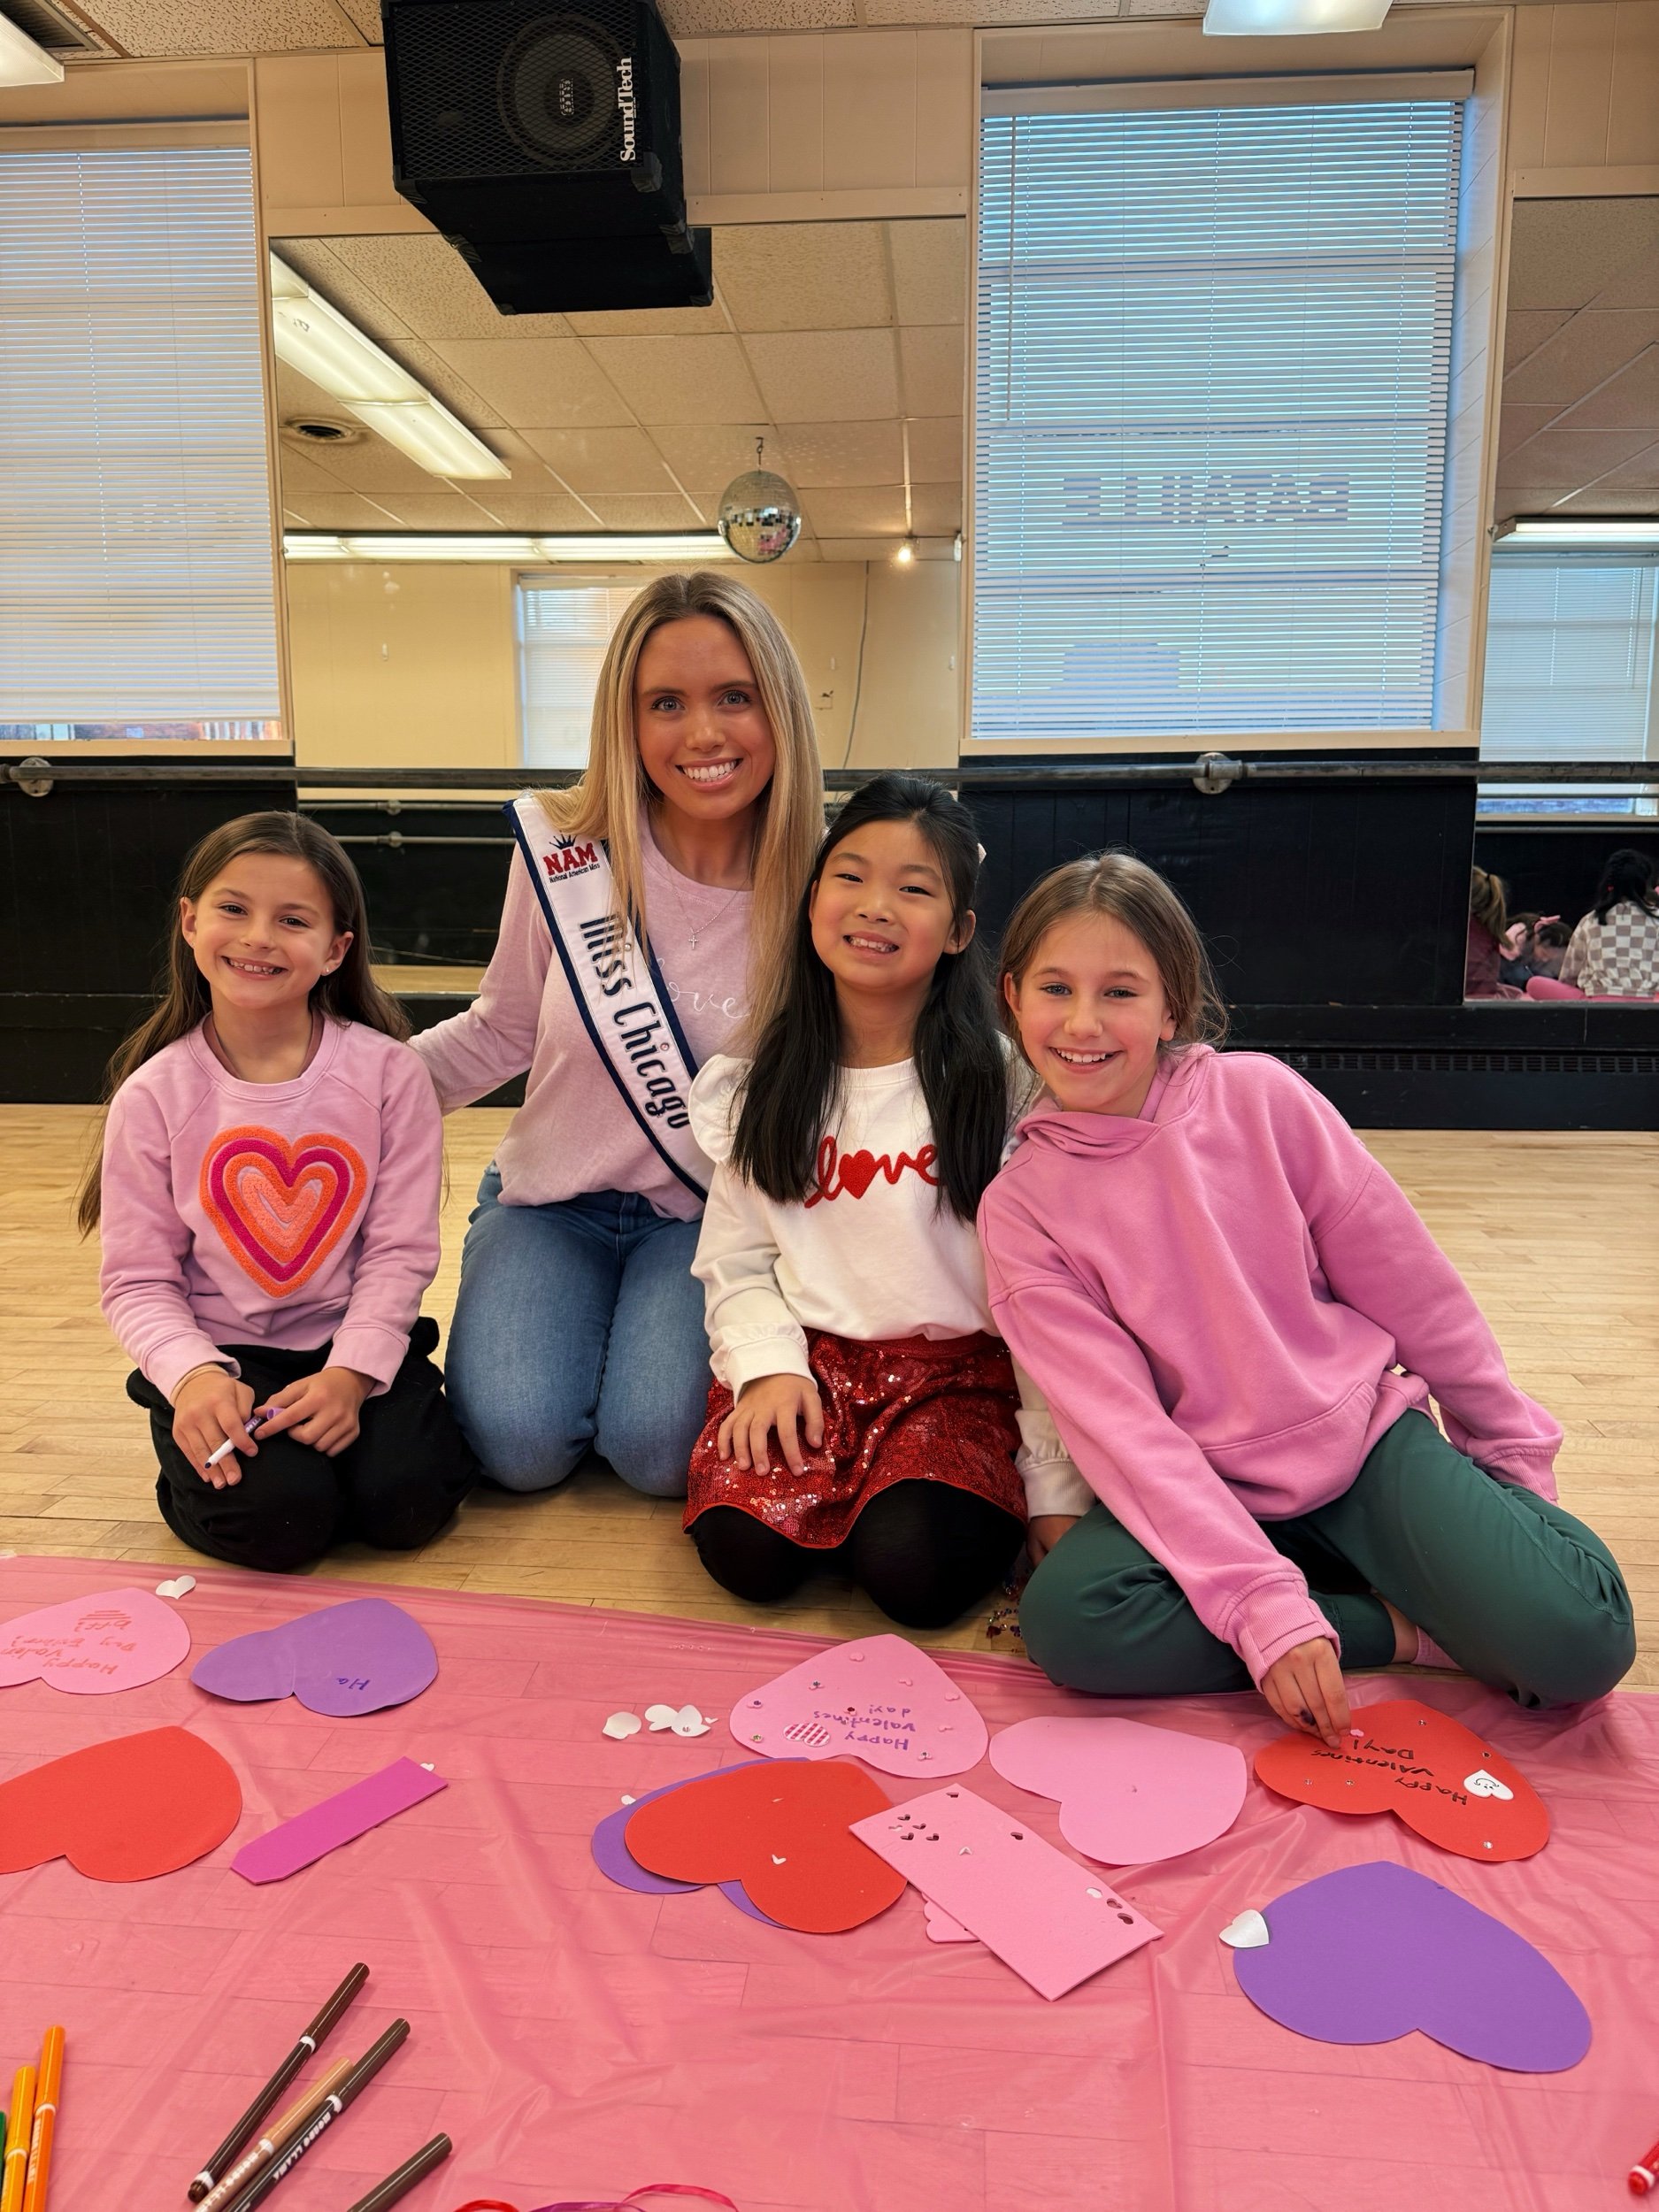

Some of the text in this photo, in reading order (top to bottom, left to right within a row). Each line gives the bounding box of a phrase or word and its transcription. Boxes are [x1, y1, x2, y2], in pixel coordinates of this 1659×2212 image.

[617, 57, 636, 162] SoundTech
[542, 842, 599, 877] NAM
[549, 863, 601, 884] National American Miss
[657, 957, 750, 1018] ove
[613, 1001, 690, 1130] Chicago
[845, 1732, 910, 1751] Happy
